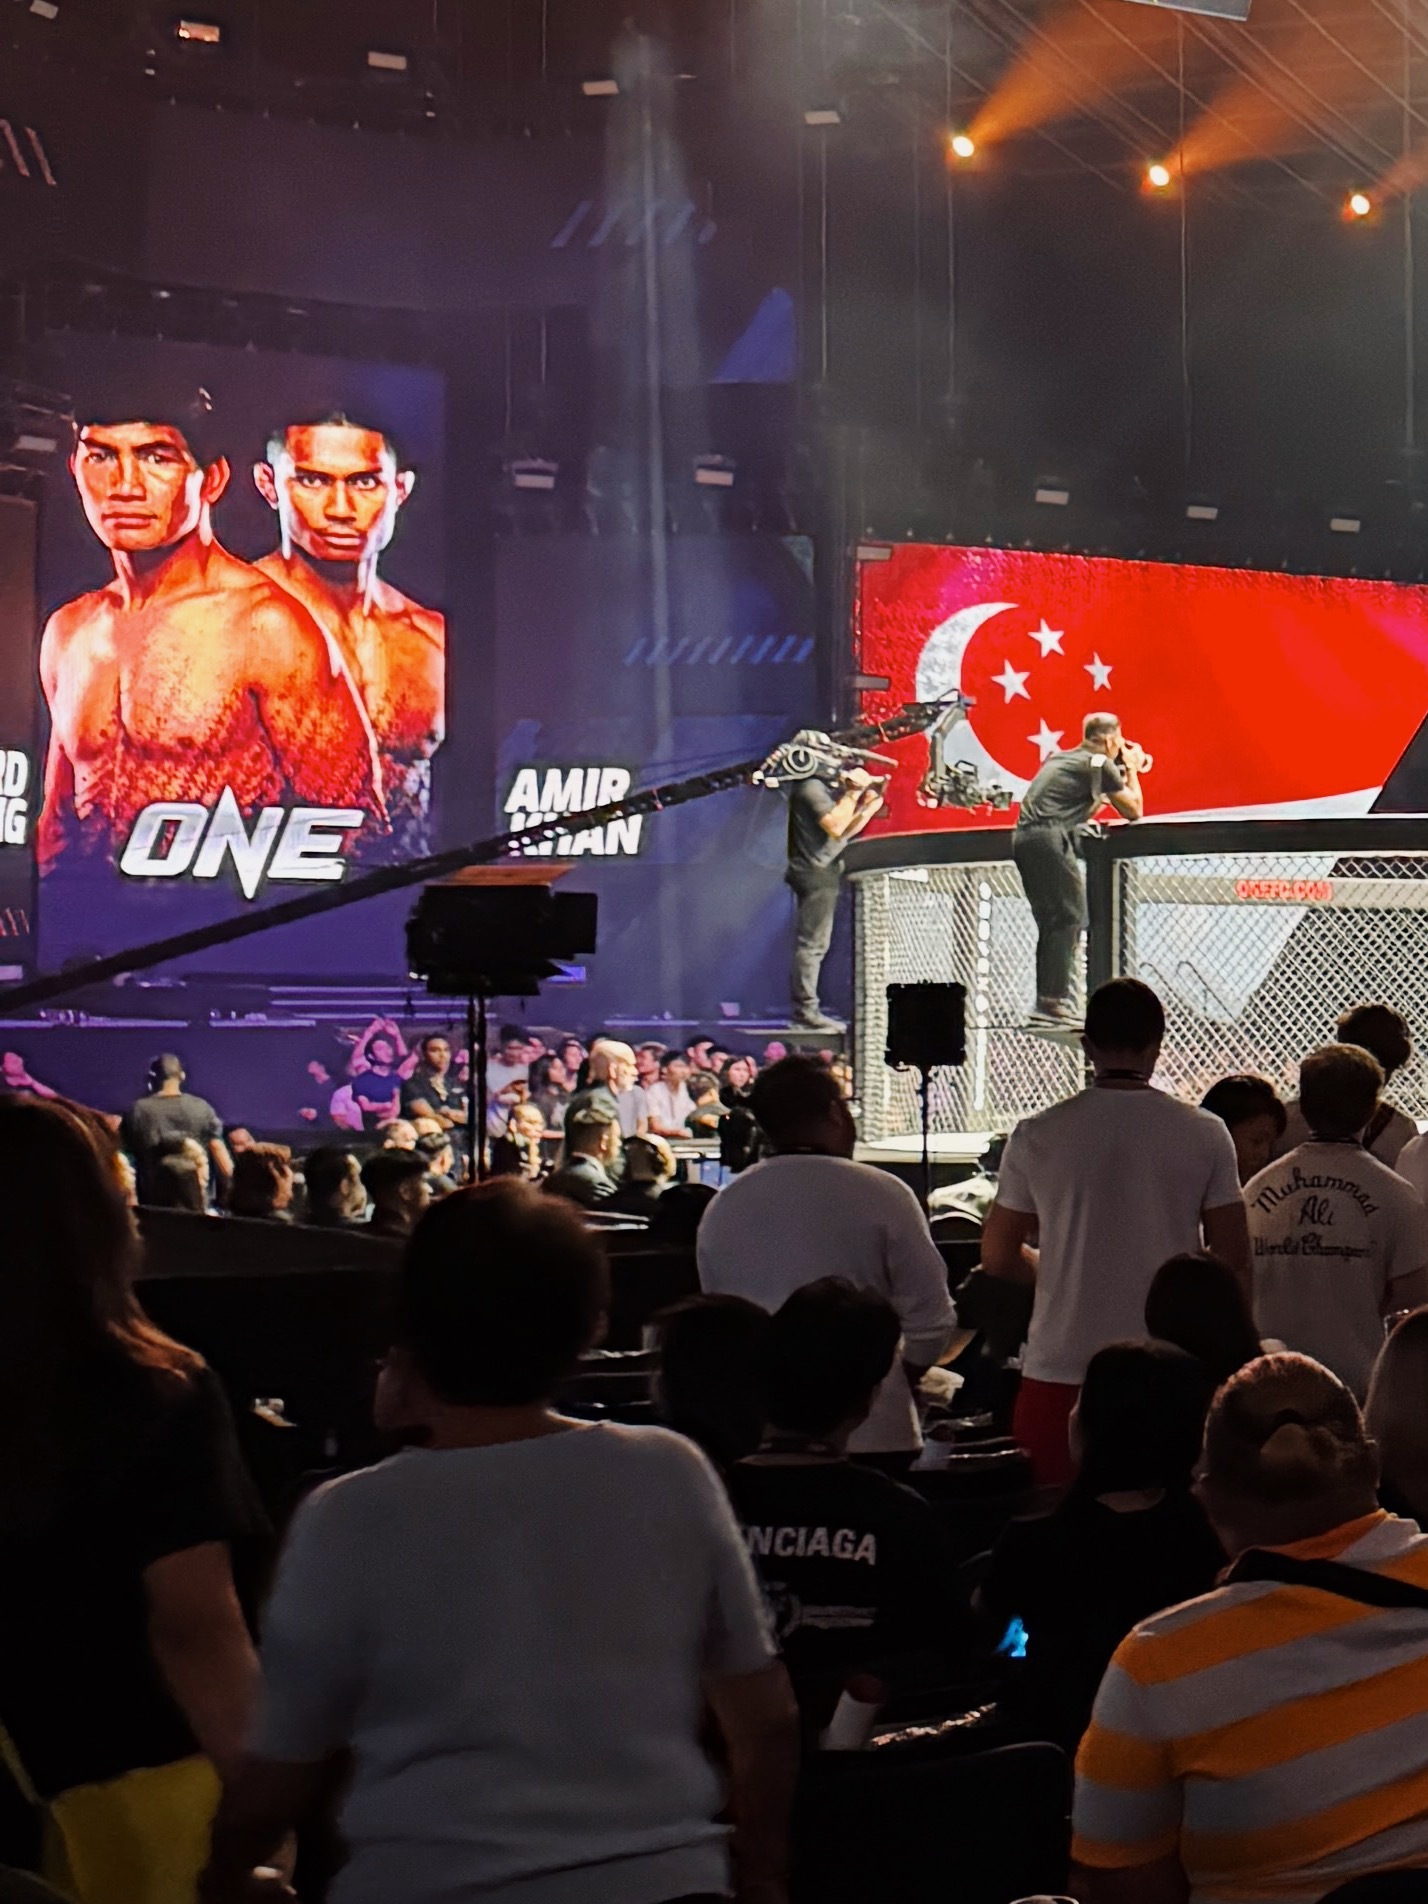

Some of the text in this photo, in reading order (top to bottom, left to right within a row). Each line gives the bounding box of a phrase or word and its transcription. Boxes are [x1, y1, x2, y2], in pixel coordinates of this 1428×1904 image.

[504, 767, 631, 813] AMIR
[120, 784, 365, 899] ONE
[1250, 1167, 1380, 1217] Muhammad
[1297, 1195, 1335, 1226] Ali
[747, 1526, 877, 1566] NCIAGA
